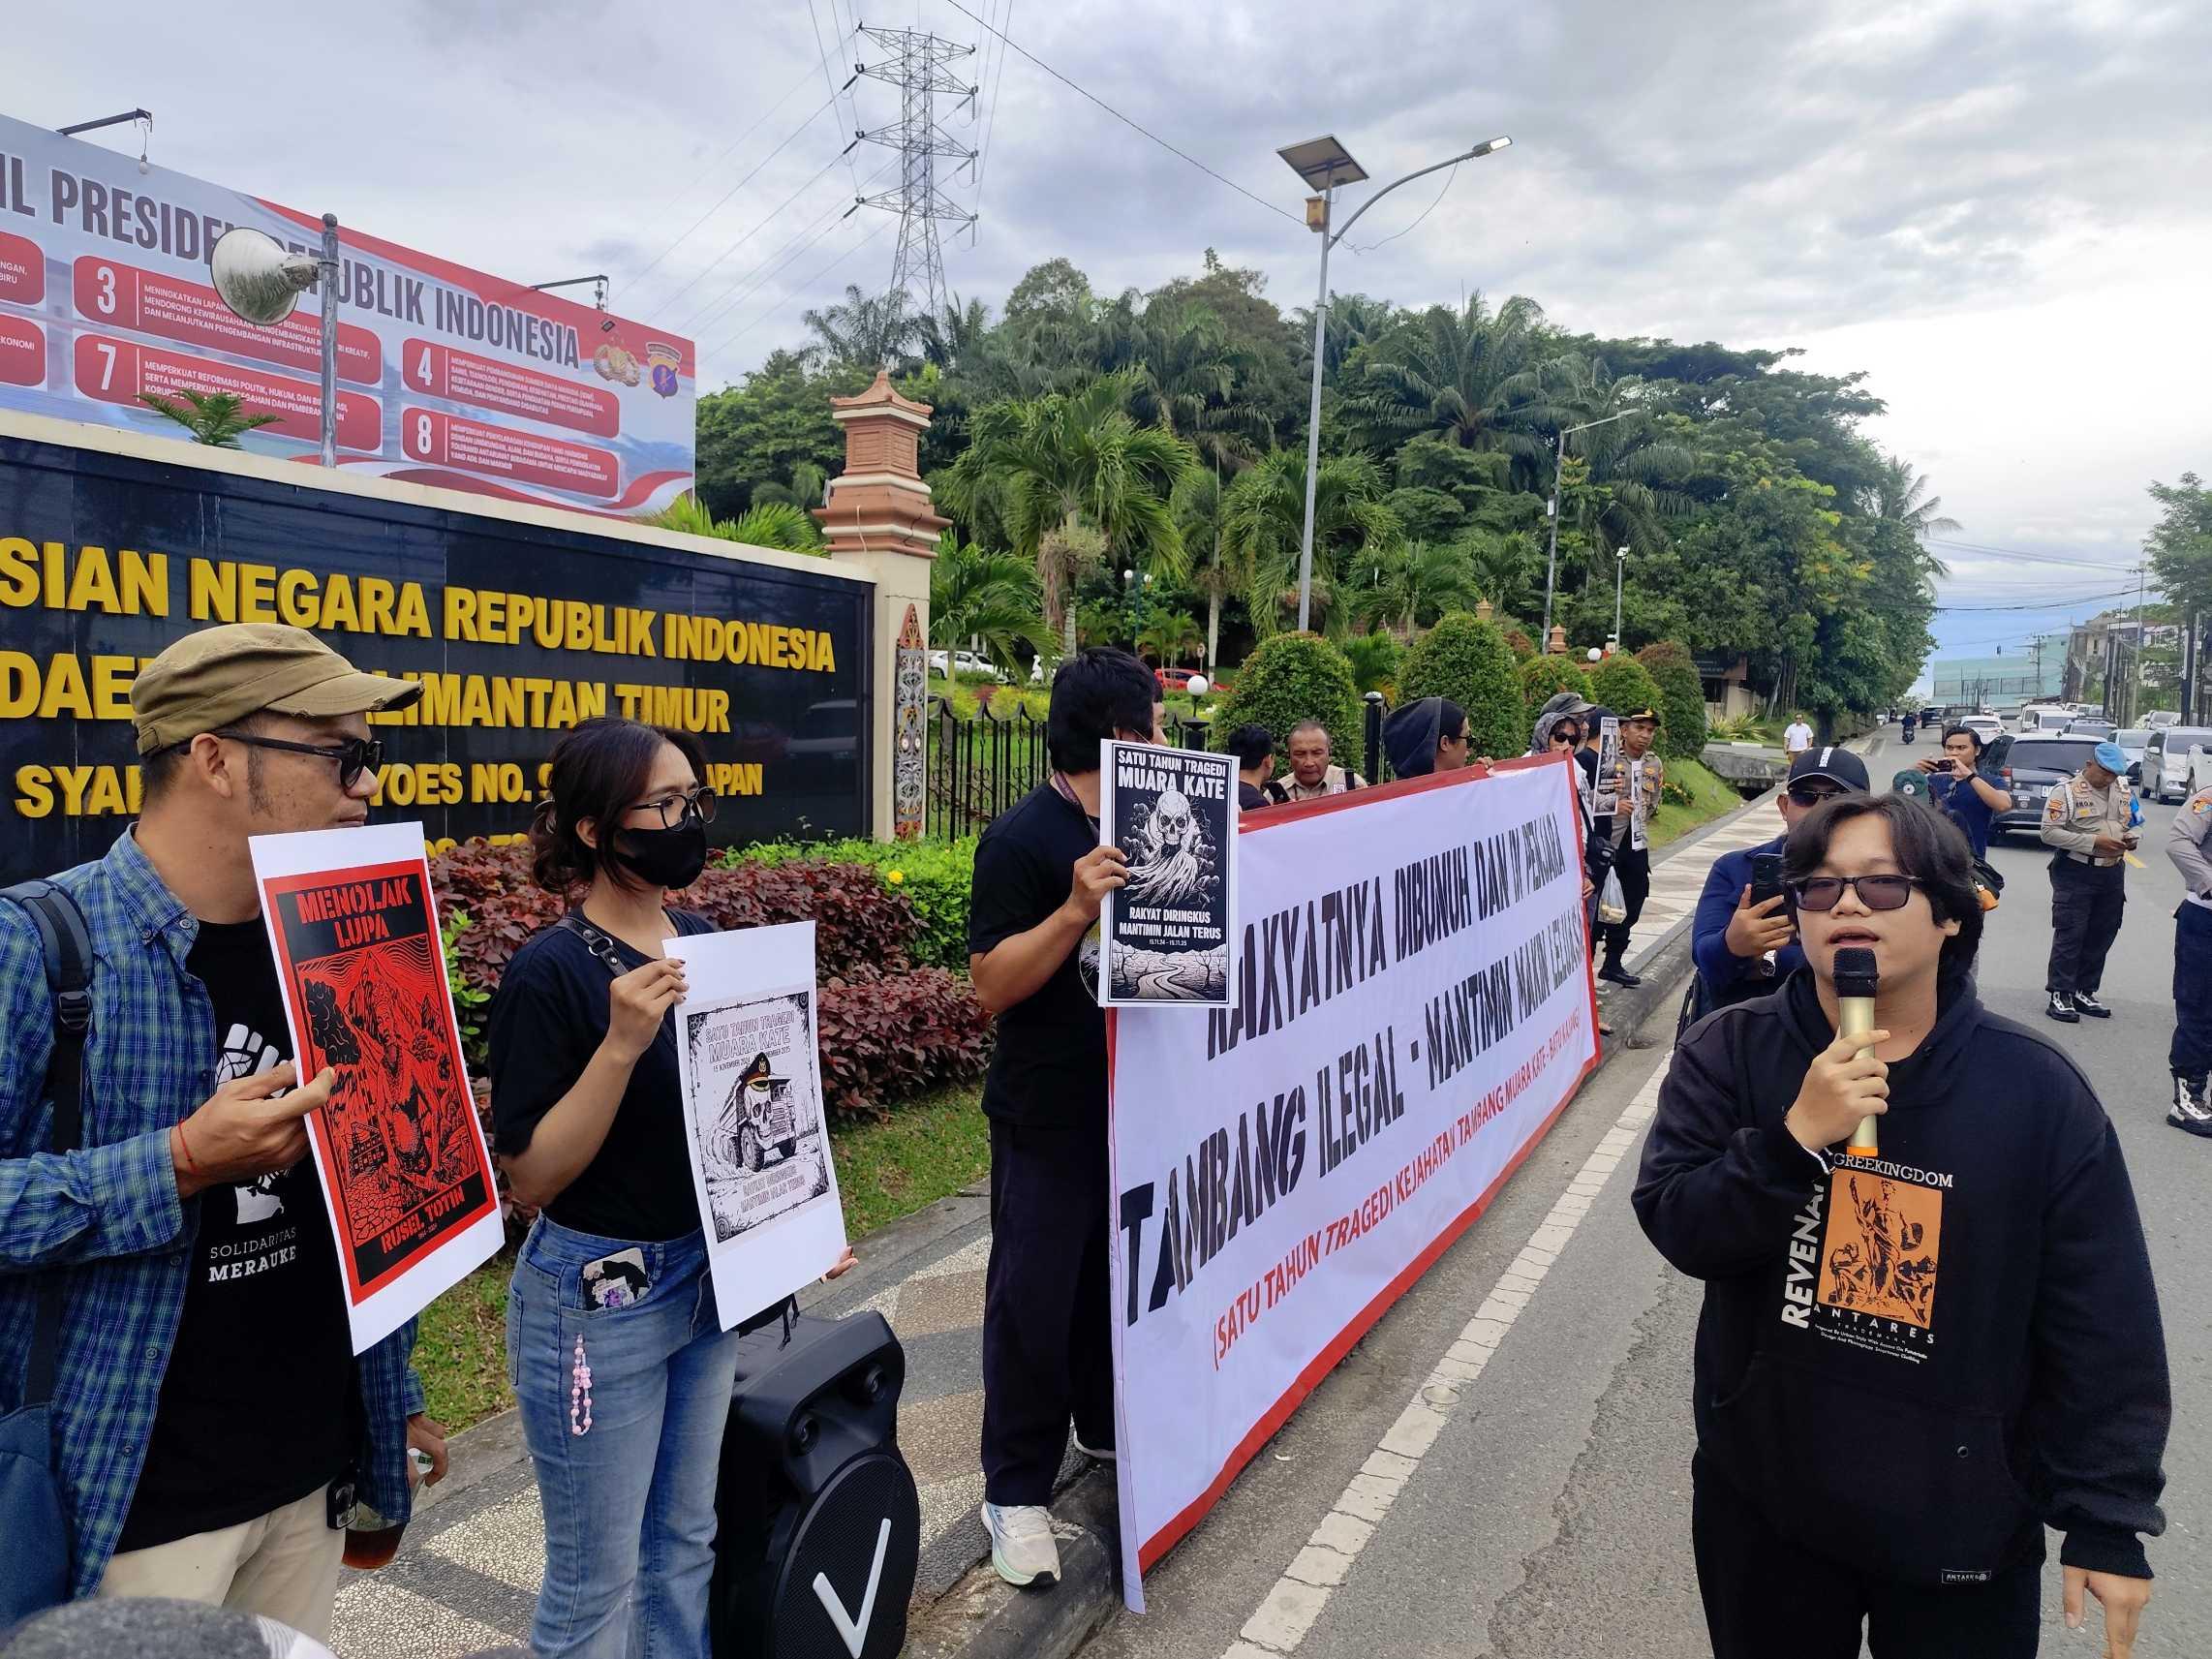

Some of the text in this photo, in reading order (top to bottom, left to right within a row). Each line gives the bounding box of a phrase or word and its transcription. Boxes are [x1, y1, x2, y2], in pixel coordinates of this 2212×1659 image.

[51, 169, 236, 265] PRESIDE
[270, 235, 424, 326] UBLIK
[437, 287, 579, 369] INDONESIA
[97, 266, 117, 315] 3
[144, 284, 232, 314] MENINGKATKAN LAPANG
[144, 295, 193, 314] MENDORONG
[144, 306, 162, 318] DAN
[162, 310, 214, 331] MELANJUTKAN
[97, 344, 117, 390] 7
[144, 360, 198, 380] MEMPERKUAT
[198, 371, 240, 387] REFORMASI
[144, 372, 169, 384] SERTA
[417, 347, 432, 386] 4
[416, 415, 432, 454] 8
[191, 557, 433, 639] NEGARA
[444, 586, 658, 659] REPUBLIK
[663, 612, 836, 673] INDONESIA
[0, 650, 155, 721] DAE
[615, 684, 730, 734] TIMUR
[1118, 750, 1226, 778] SATU TAHUN TRAGEDI
[1118, 765, 1225, 800] MUARA KATE
[369, 762, 464, 807] YOES
[471, 762, 532, 805] NO.
[295, 876, 413, 924] MENOLAK
[1395, 845, 1472, 963] DIBUNUH
[1473, 833, 1511, 921] DAN
[1521, 812, 1566, 896] PENJARA
[334, 913, 390, 949] LUPA
[1119, 922, 1222, 939] MANTIMIN JALAN TERUS
[1129, 906, 1211, 924] RAKYAT DIRINGKUS
[708, 1025, 791, 1063] MUARA KATE
[1120, 1084, 1307, 1328] TAMBANG
[1316, 1025, 1404, 1179] ILEGAL
[1425, 955, 1514, 1091] MANTIMIN
[1513, 928, 1551, 1025] MAKIN
[1833, 1152, 1953, 1188] GREEKINGDOM
[381, 1213, 425, 1254] RUSEL
[424, 1184, 466, 1222] TOTIN
[1213, 1280, 1260, 1372] (SATU
[1264, 1229, 1322, 1310] TAHUN
[1324, 1180, 1394, 1256] TRAGEDI
[1395, 1121, 1456, 1207] KEJAHATAN
[1457, 1084, 1505, 1147] TAMBANG
[1504, 1060, 1532, 1105] MUARA
[209, 1226, 296, 1259] SOLIDARITAS
[1781, 1183, 1825, 1330] REVENA
[208, 1245, 297, 1282] MERAUKE
[1813, 1303, 1935, 1344] ANTARES
